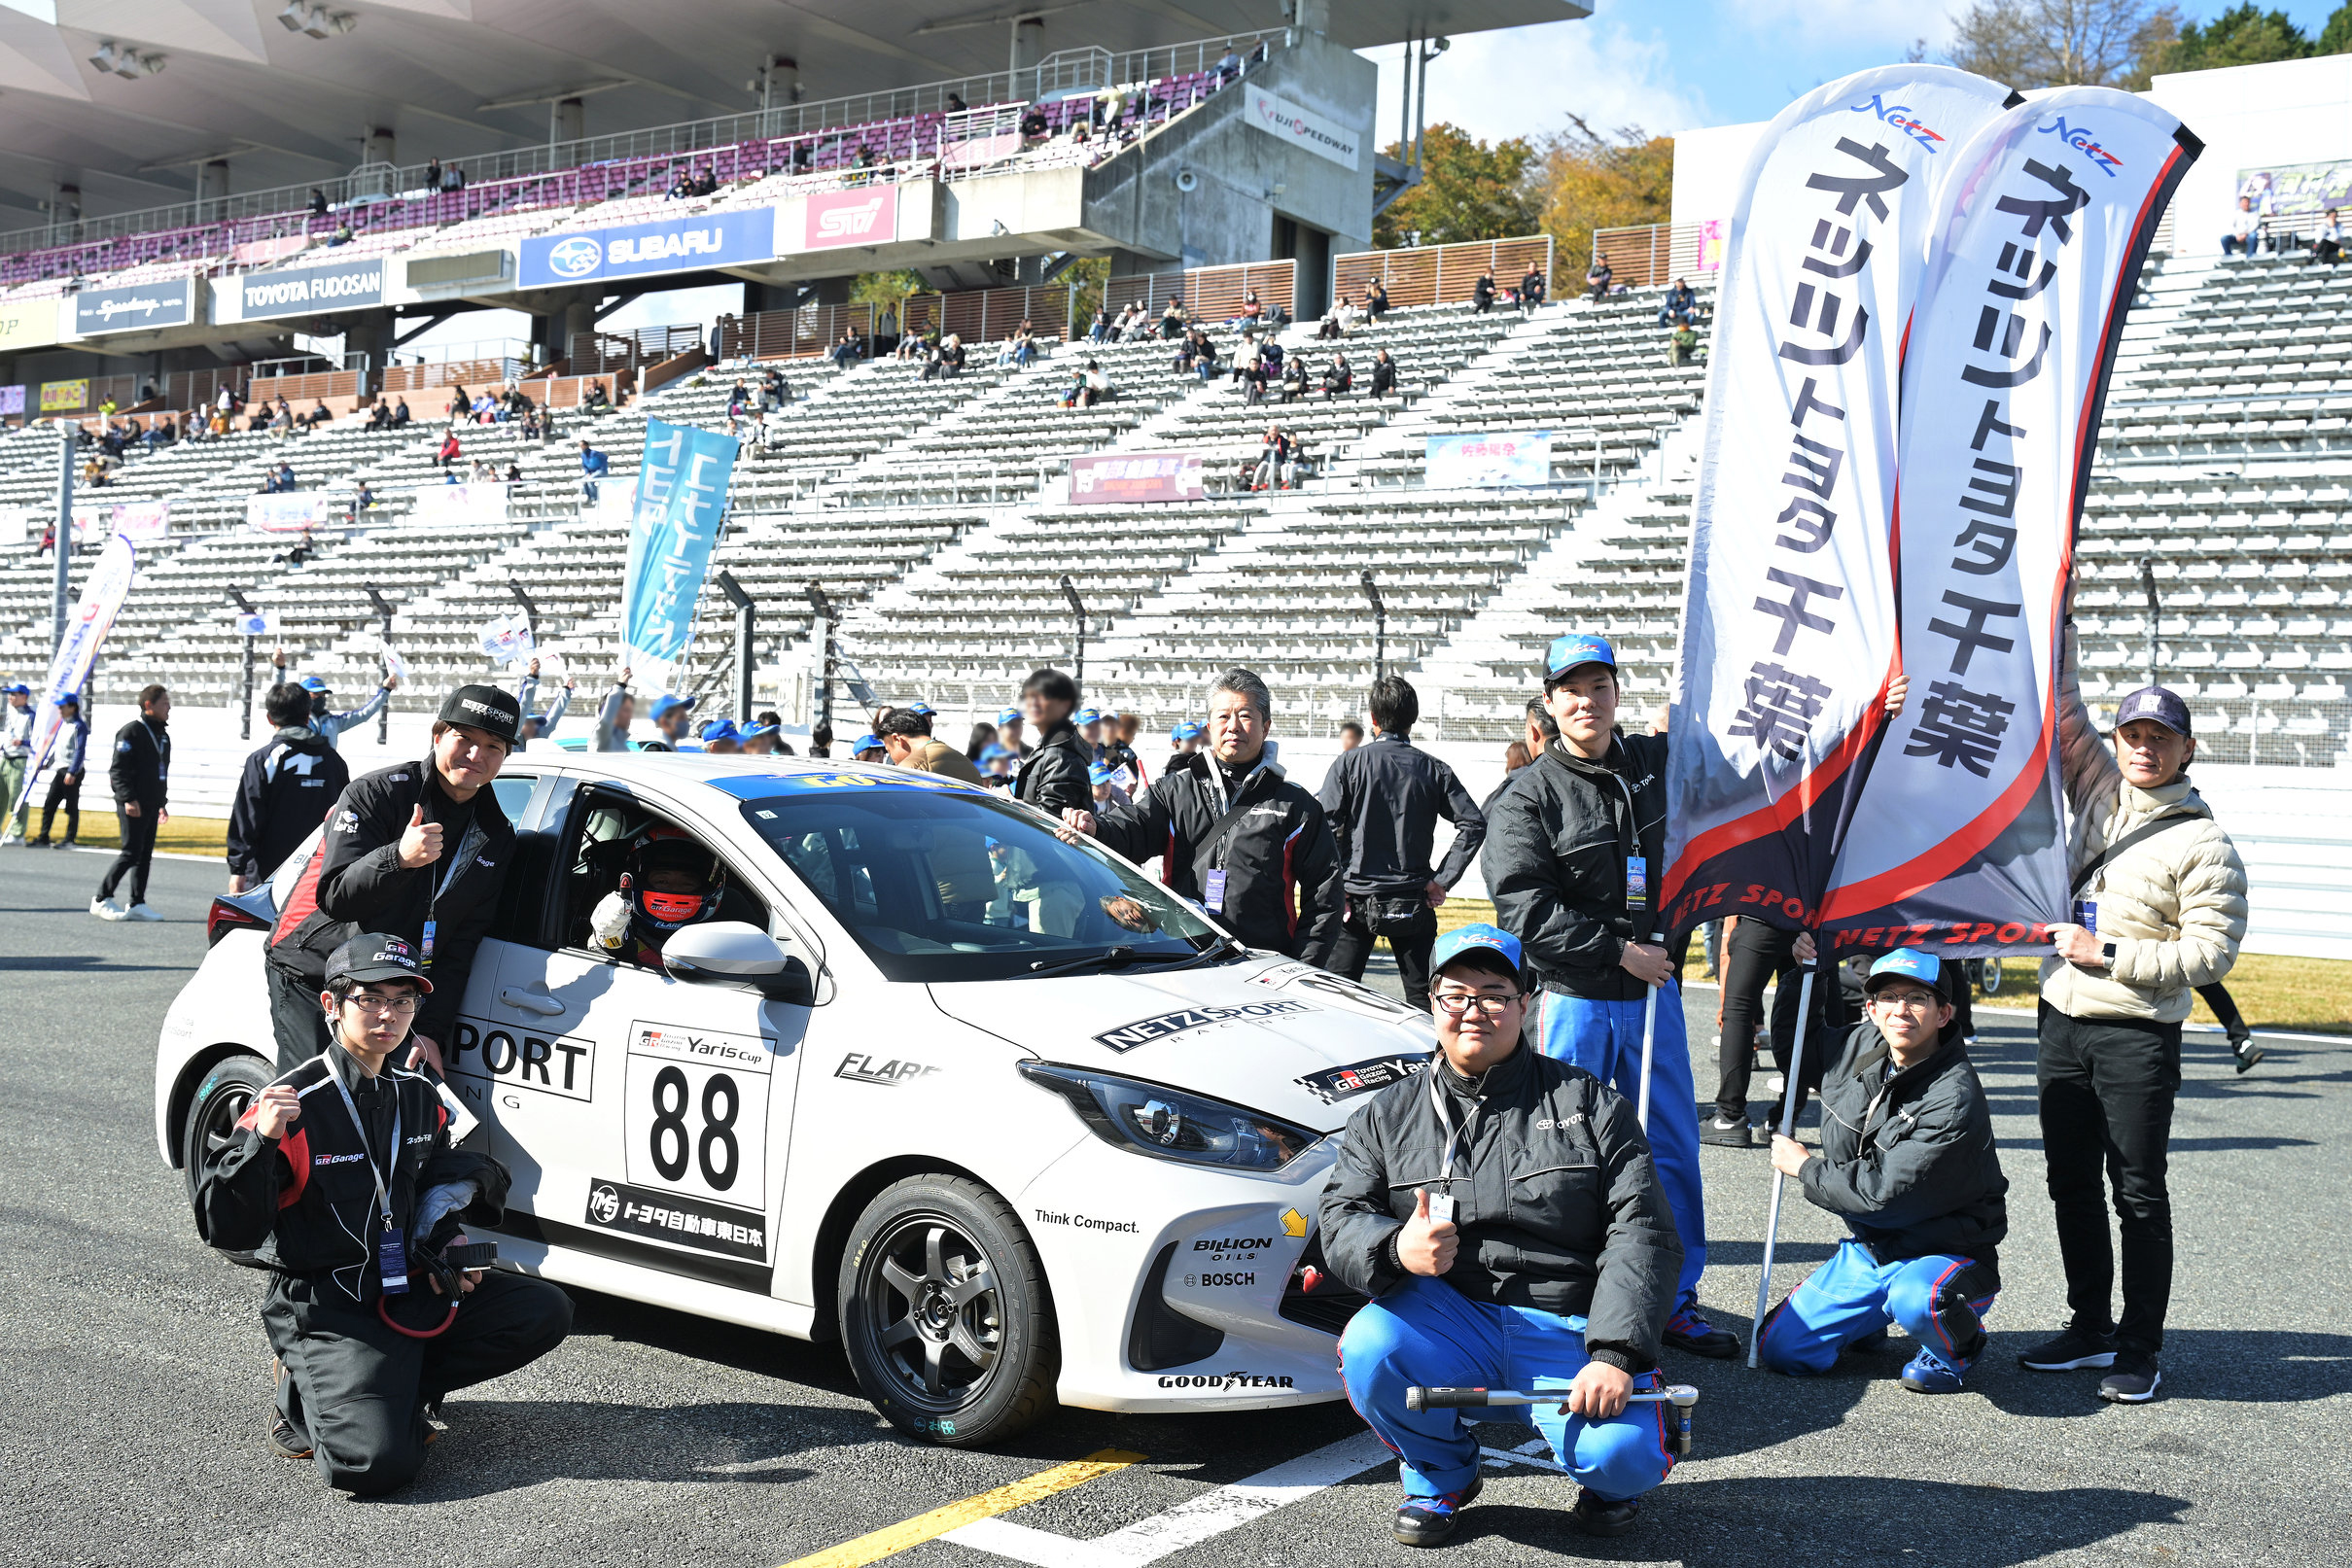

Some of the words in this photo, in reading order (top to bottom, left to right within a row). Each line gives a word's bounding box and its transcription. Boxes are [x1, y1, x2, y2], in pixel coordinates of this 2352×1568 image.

[1850, 94, 1946, 155] Netz
[2038, 116, 2124, 178] Netz
[608, 226, 723, 264] SUBARU
[244, 279, 311, 308] TOYOTA
[310, 271, 381, 299] FUDOSAN
[1727, 135, 1910, 762] ネッツトヨタ千葉
[1903, 157, 2091, 780] ネッツトヨタ千葉
[475, 855, 496, 867] Grage
[663, 905, 693, 914] Garage
[1739, 883, 1821, 930] SPOR
[1834, 923, 1940, 949] NETZ
[1944, 922, 2054, 945] SPOR
[372, 952, 416, 968] Garage
[1103, 1010, 1198, 1050] NETZ
[1201, 1000, 1310, 1021] SPORT
[450, 1021, 587, 1091] PORT
[687, 1036, 738, 1058] Yaris
[739, 1051, 762, 1064] Cup
[1353, 1064, 1386, 1075] TOYOTA
[1359, 1069, 1387, 1080] GAZOO
[1383, 1058, 1431, 1076] Yari
[1334, 1076, 1363, 1091] GR
[1363, 1074, 1392, 1086] Racing
[650, 1065, 740, 1192] 88
[332, 1153, 365, 1165] Garage
[623, 1201, 764, 1247] トヨタ自動車東日本
[1035, 1209, 1071, 1226] Think
[1073, 1214, 1140, 1234] Compact.
[1193, 1237, 1273, 1252] BILLION
[1210, 1252, 1258, 1262] OILS
[1201, 1272, 1255, 1287] BOSCH
[1157, 1374, 1294, 1390] GOODYEAR
